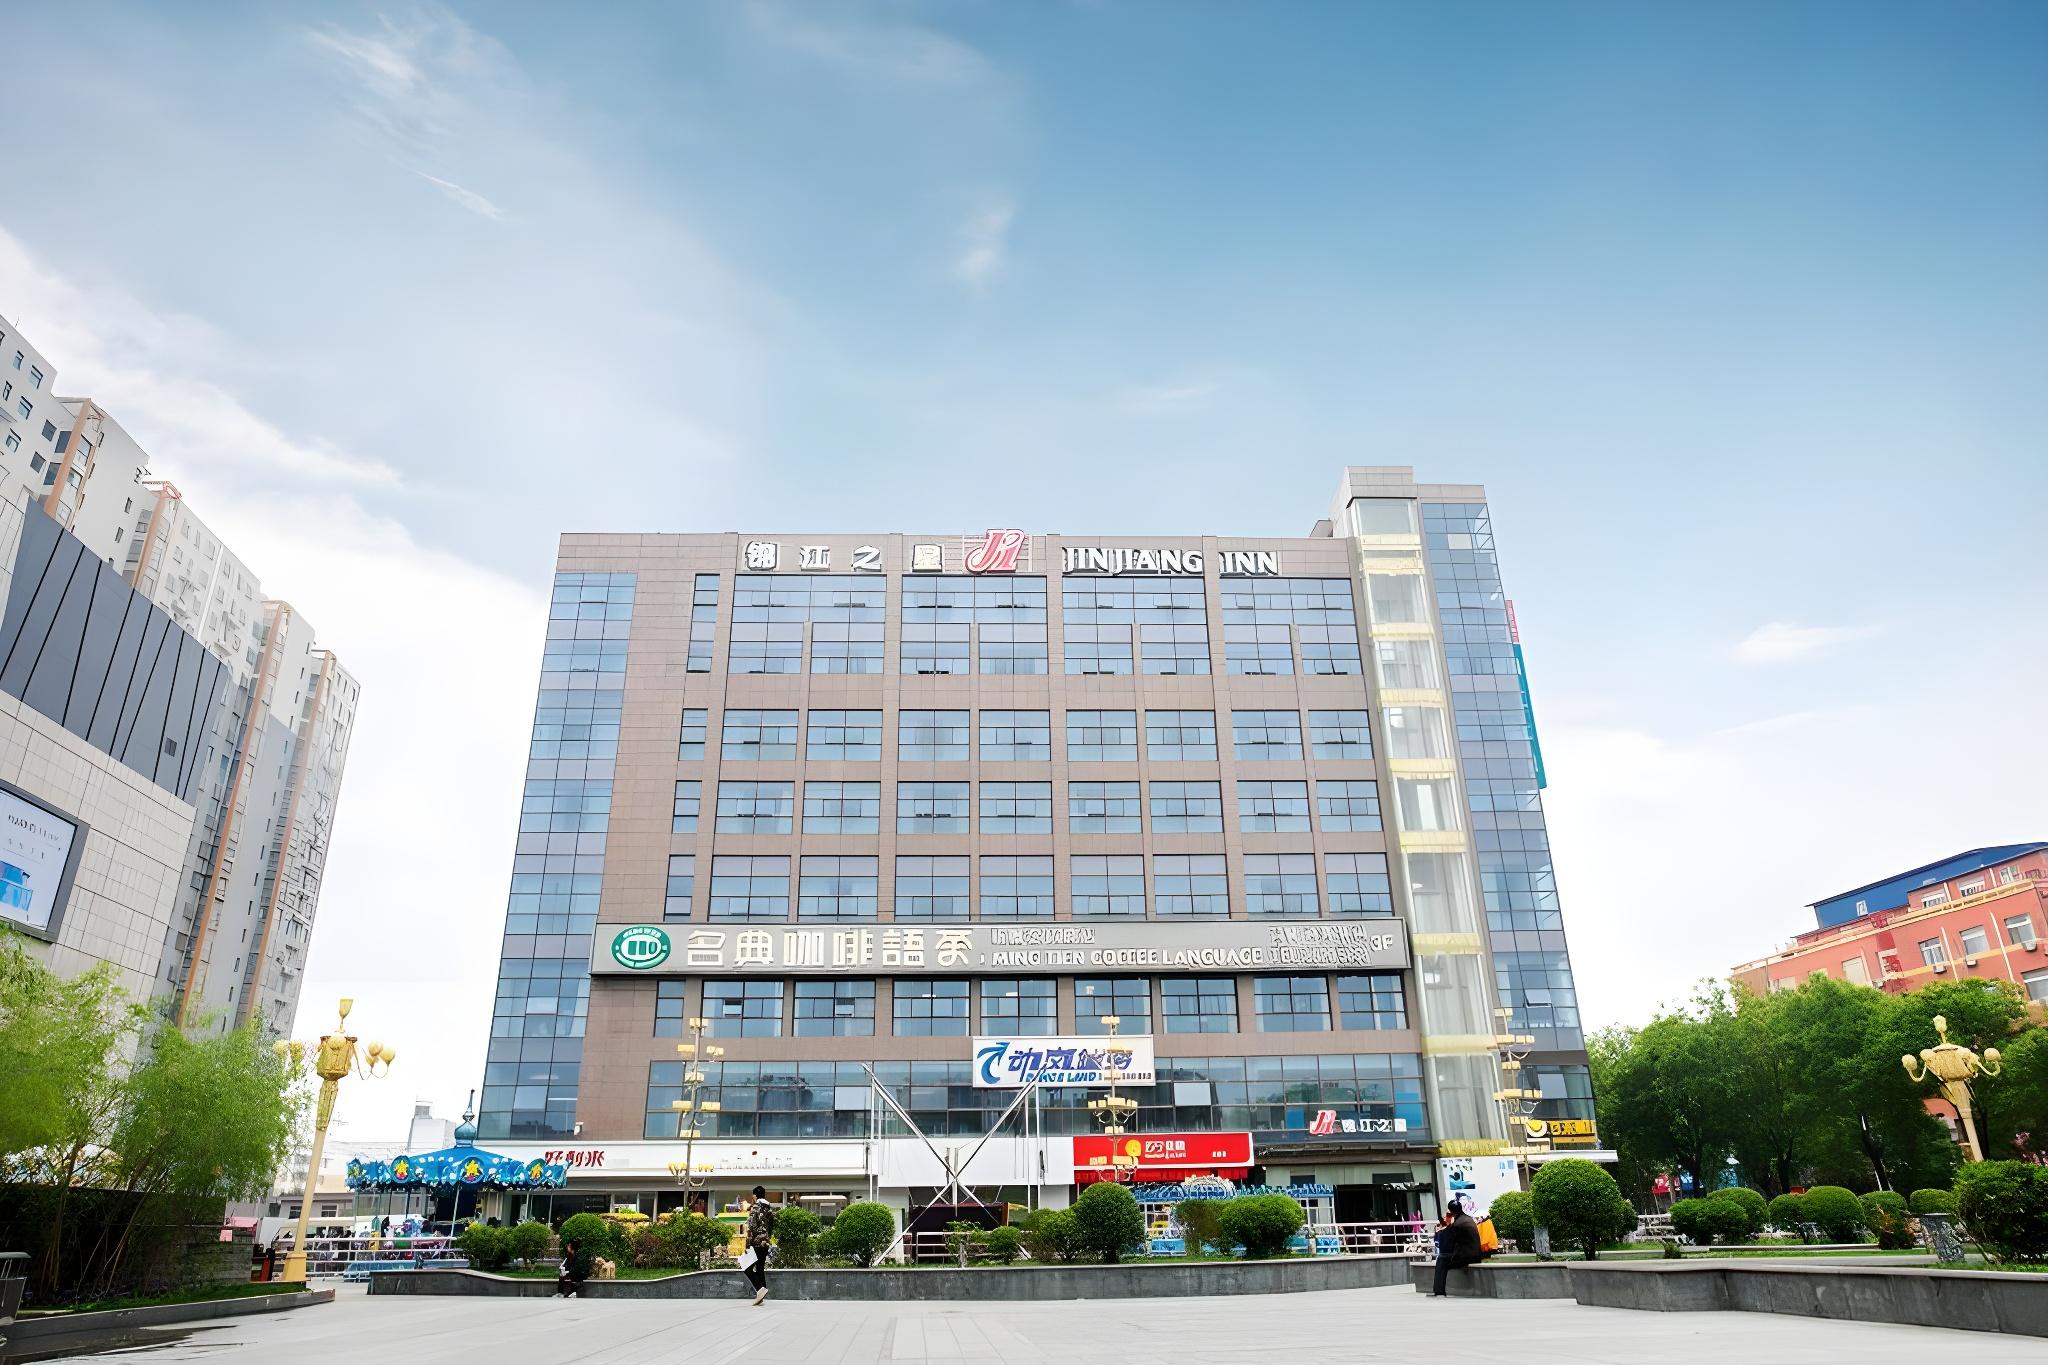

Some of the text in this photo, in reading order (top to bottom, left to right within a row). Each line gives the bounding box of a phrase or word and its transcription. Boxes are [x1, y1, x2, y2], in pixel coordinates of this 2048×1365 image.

[1062, 546, 1279, 577] JINJIANG INN
[1162, 947, 1263, 967] LANGUAGE
